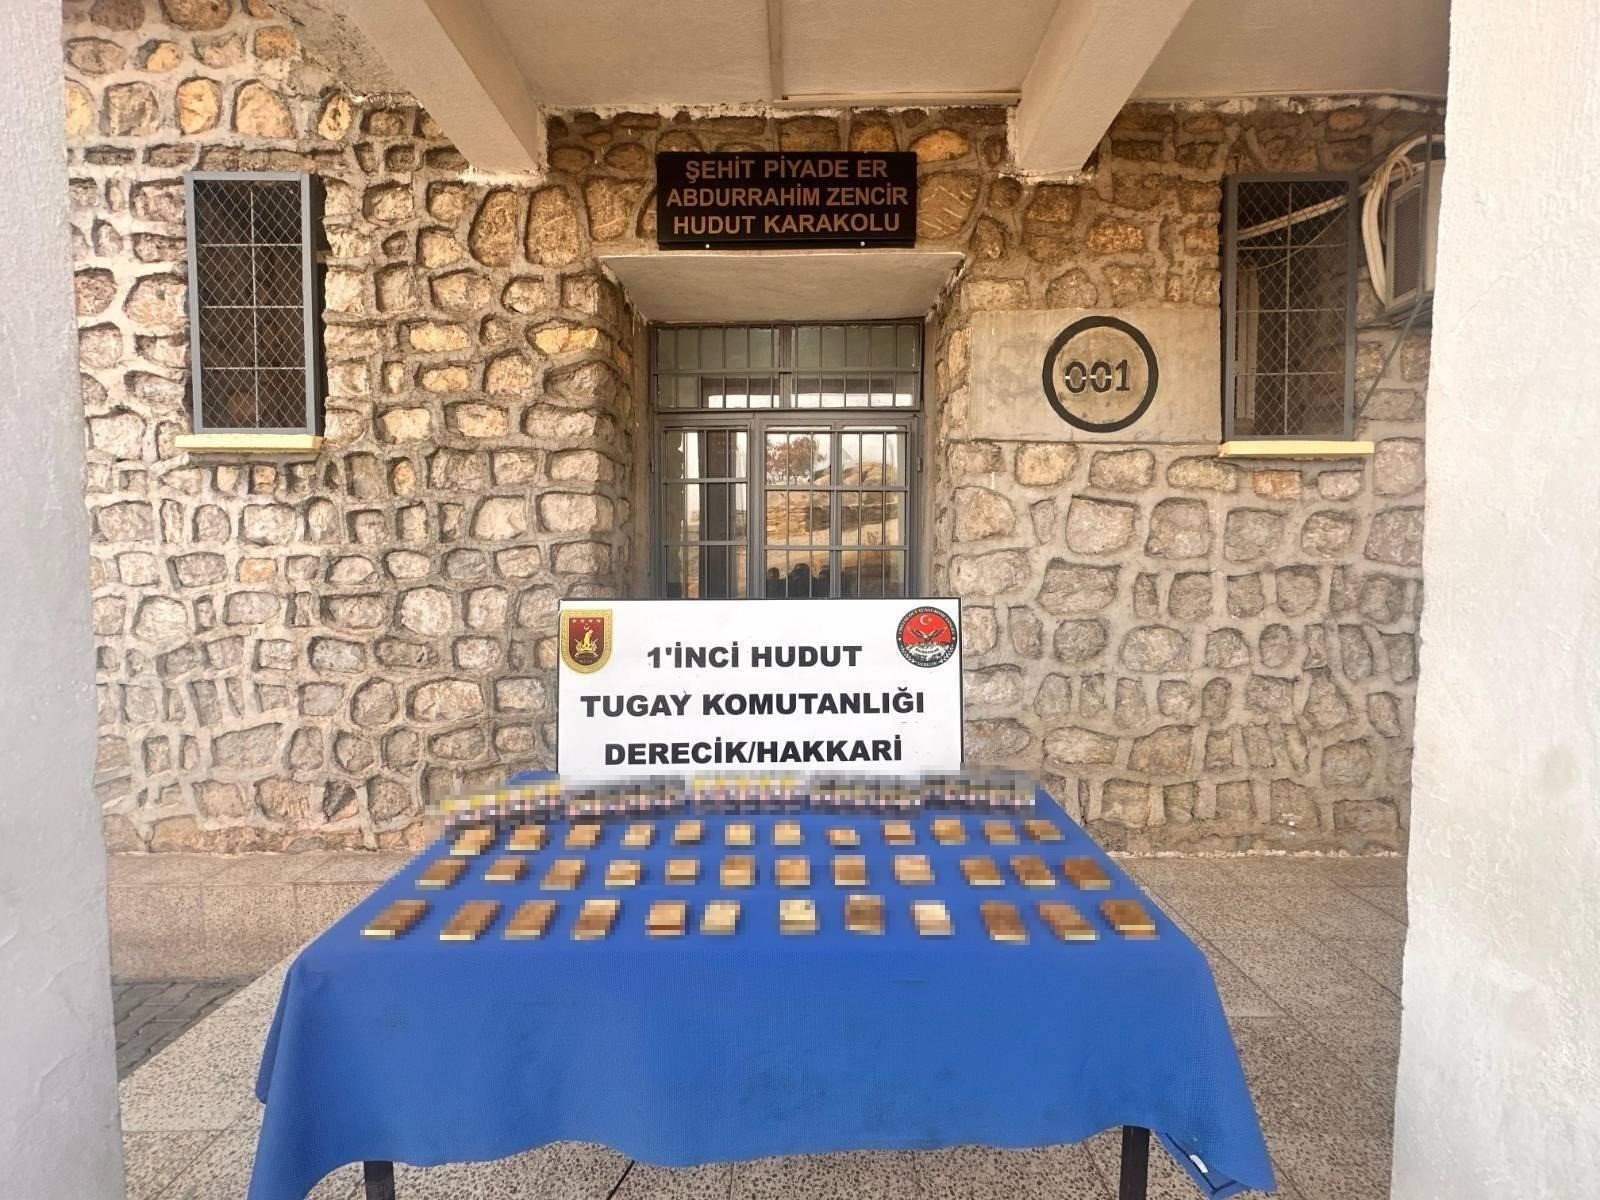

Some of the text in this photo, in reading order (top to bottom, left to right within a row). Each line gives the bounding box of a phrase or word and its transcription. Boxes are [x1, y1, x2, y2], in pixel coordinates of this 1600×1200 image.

[686, 155, 888, 183] ŞEHİT PİYADE ER
[666, 183, 908, 207] ABDURRAHİM ZENCİR
[673, 213, 900, 235] HUDUT KARAKOLU
[1065, 359, 1130, 394] 001
[648, 641, 863, 669] 1'İNCİ HUDUT
[580, 686, 924, 718] TUGAY KOMUTANLIĞI
[606, 735, 902, 766] DERECİK/HAKKARİ
